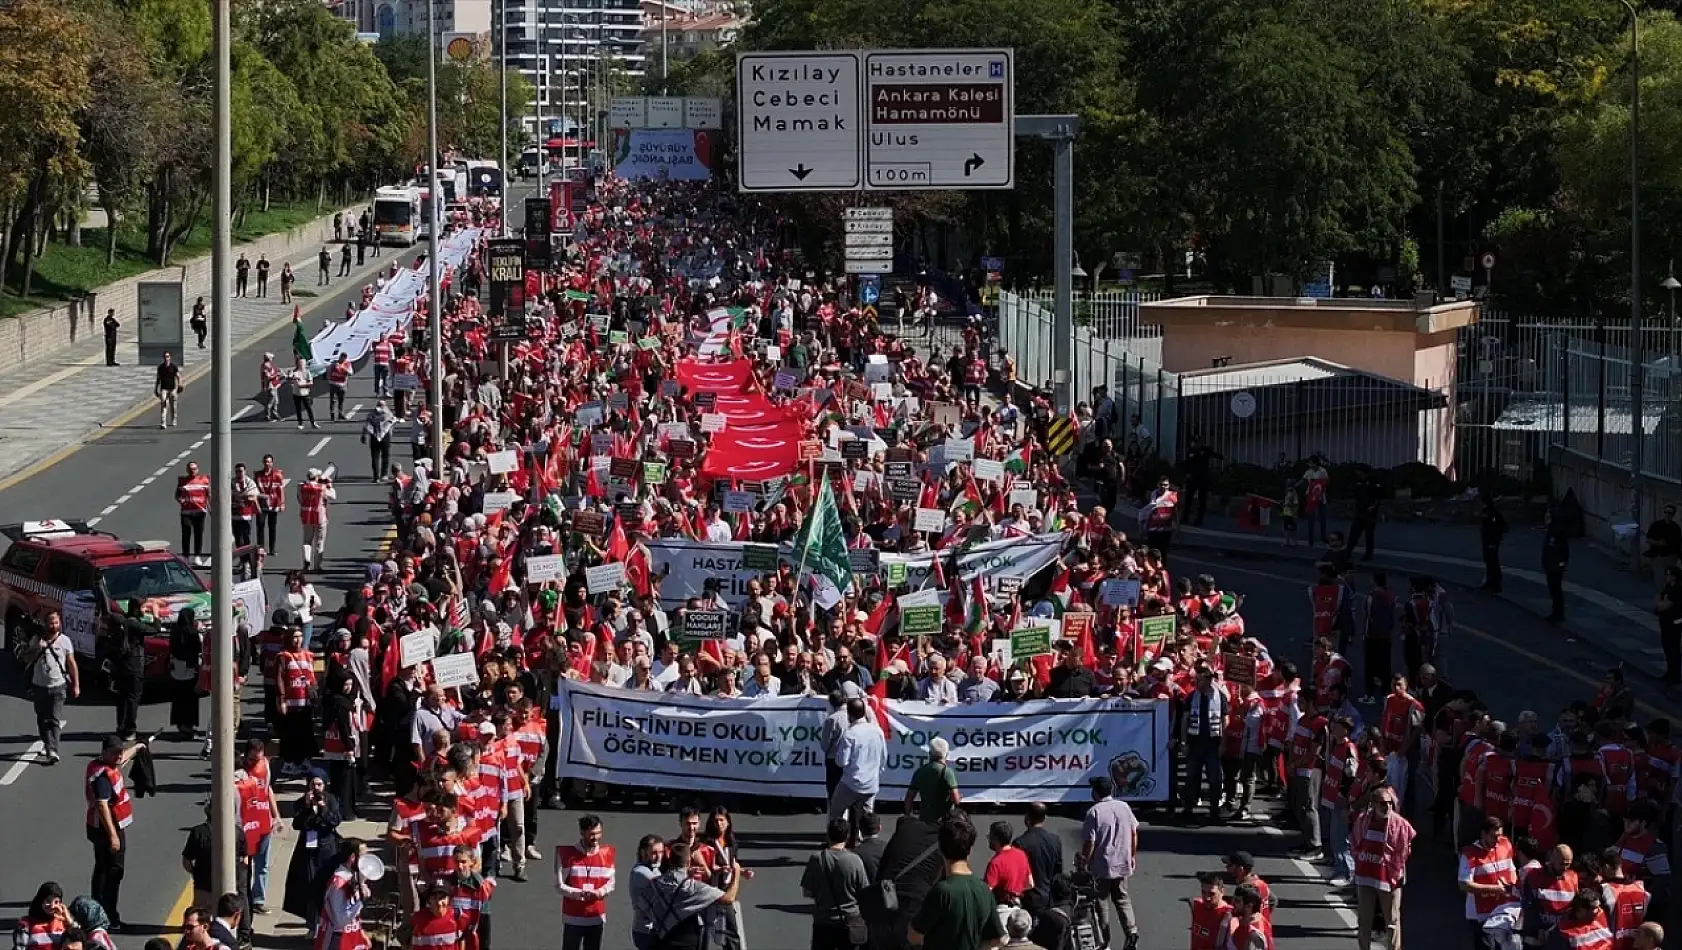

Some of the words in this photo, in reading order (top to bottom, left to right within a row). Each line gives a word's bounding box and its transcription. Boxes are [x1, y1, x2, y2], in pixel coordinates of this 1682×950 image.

[752, 64, 839, 83] Kızılay
[870, 62, 982, 76] Hastaneler
[753, 90, 839, 106] Cebeci
[878, 88, 940, 101] Ankara
[948, 88, 999, 101] Kalesi
[876, 106, 980, 119] Hamamönü
[754, 114, 845, 131] Mamak
[872, 132, 919, 145] Ulus
[582, 706, 707, 737] FİLİSTİN'DE
[712, 722, 774, 742] OKUL
[953, 726, 1053, 748] ÖĞRENCİ
[1058, 728, 1108, 746] YOK,
[603, 733, 728, 765] ÖĞRETMEN
[955, 757, 998, 772] SEN
[1004, 754, 1091, 771] SUSMA!
